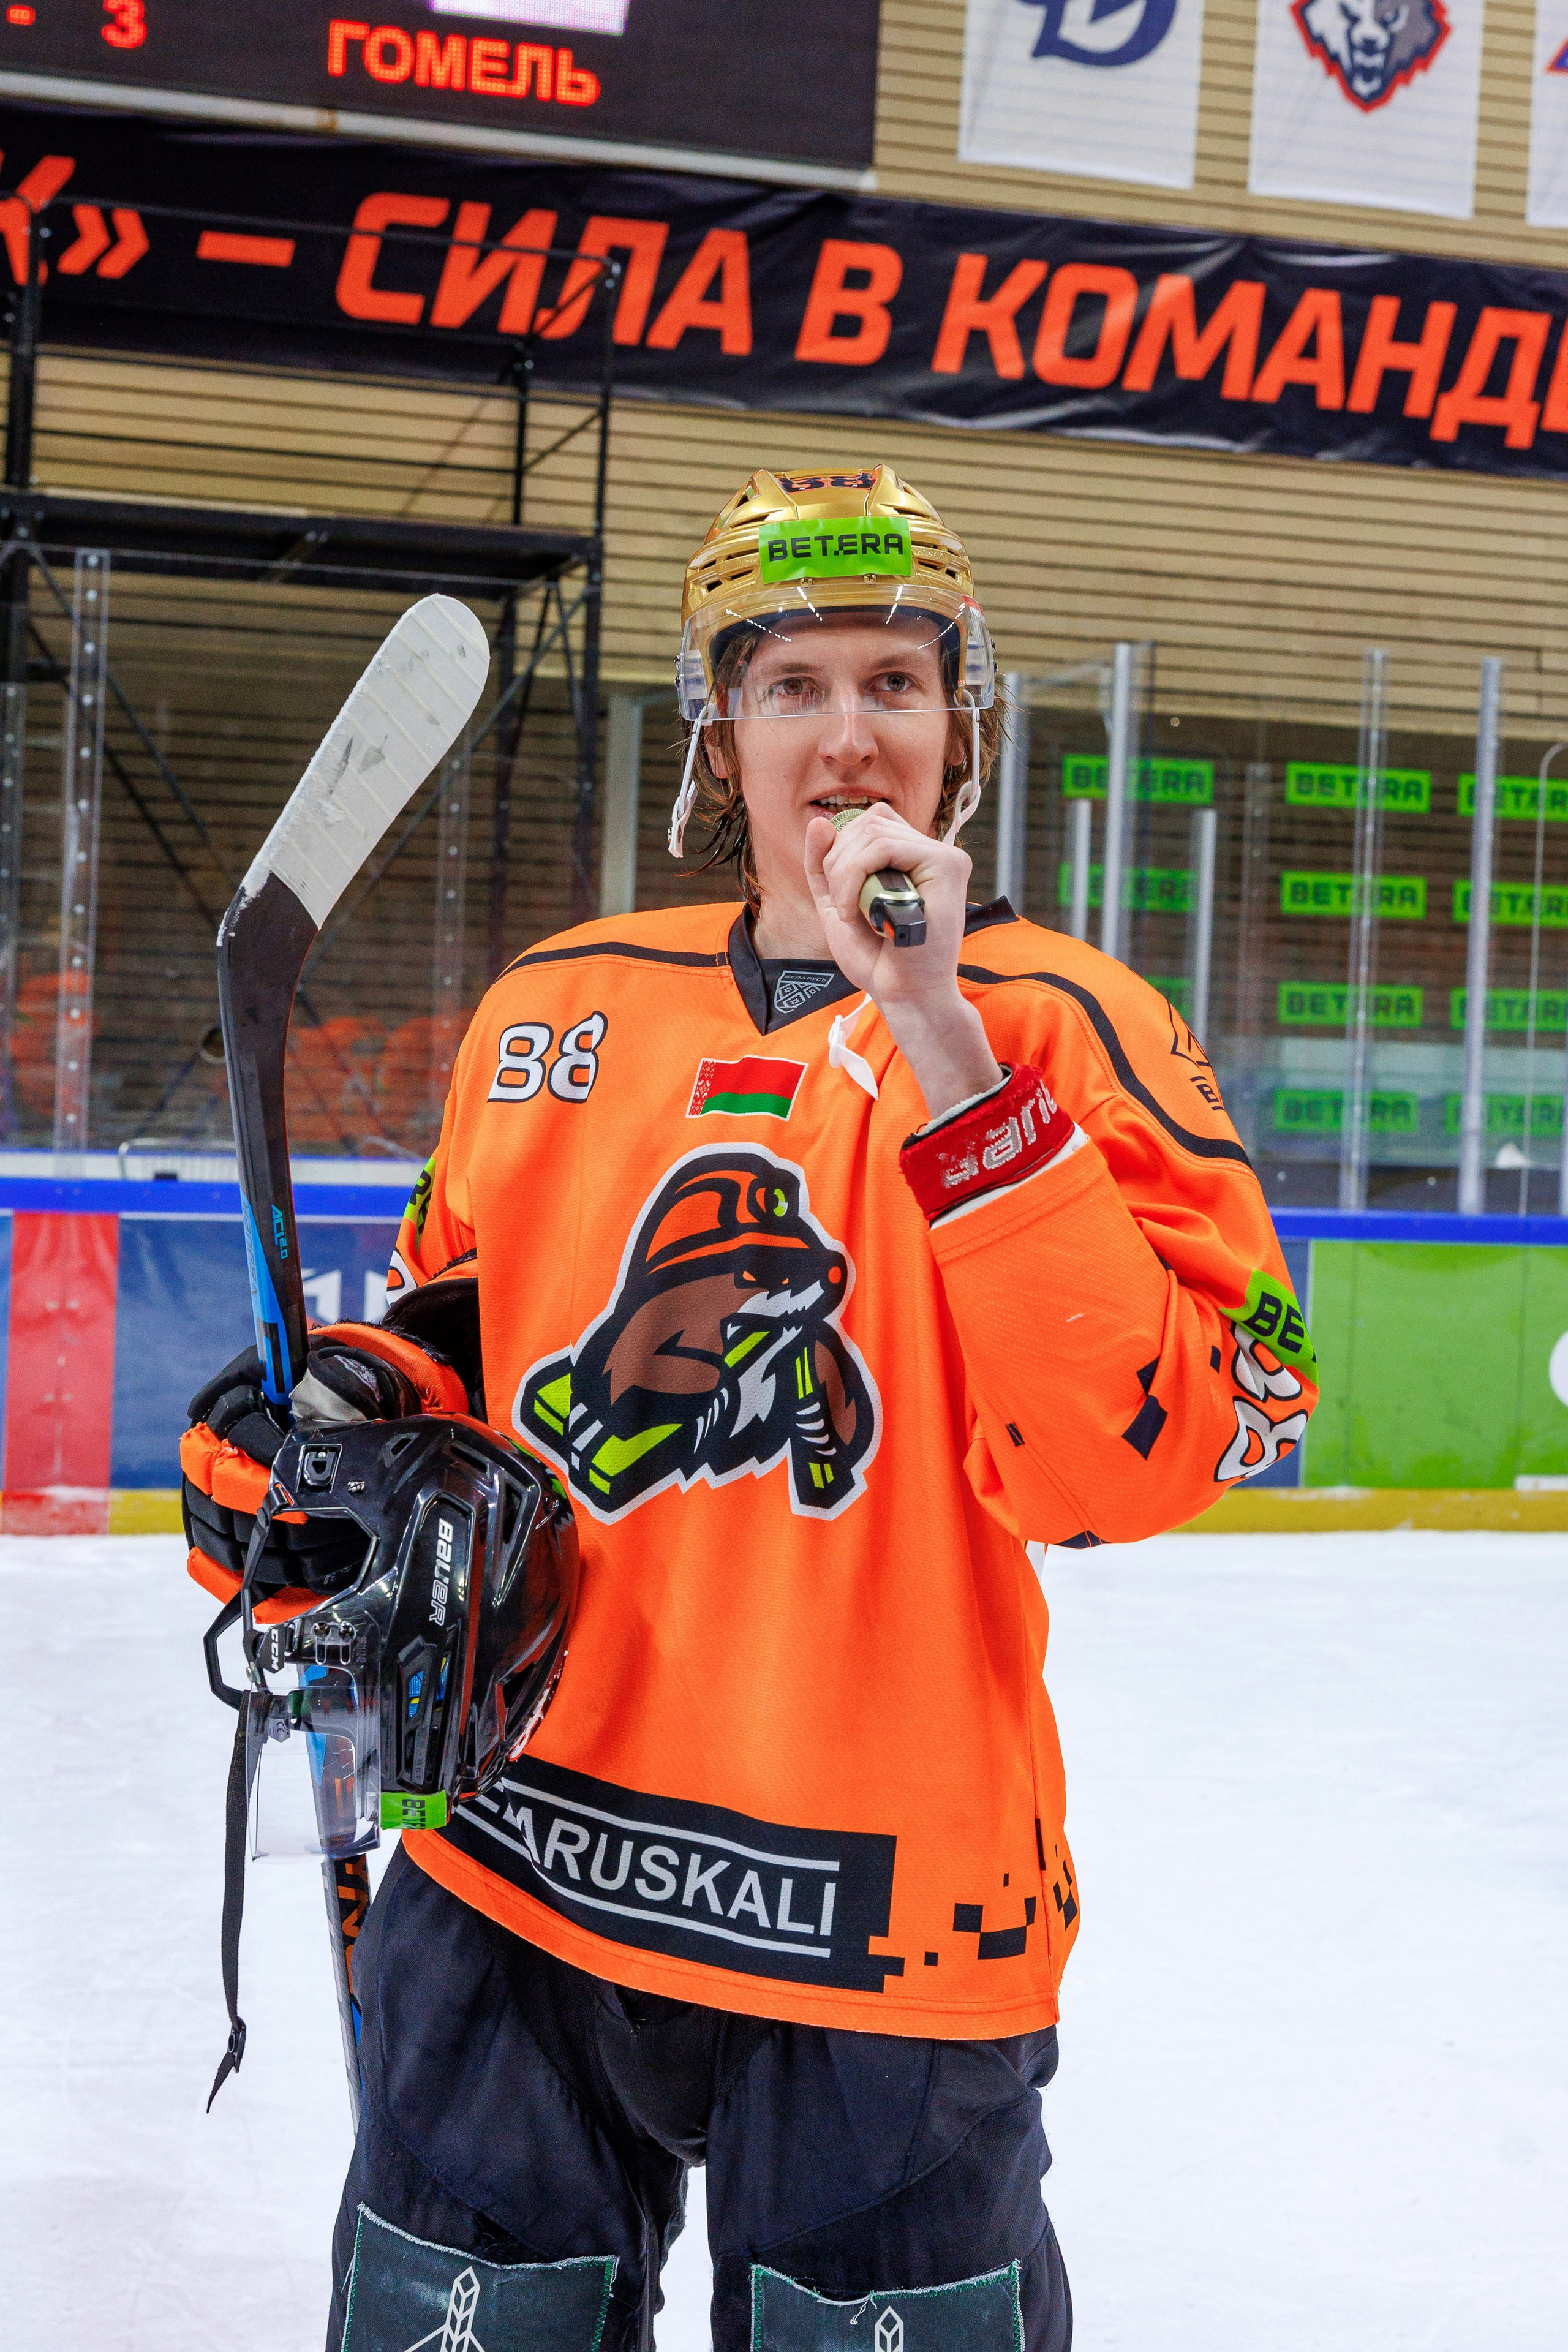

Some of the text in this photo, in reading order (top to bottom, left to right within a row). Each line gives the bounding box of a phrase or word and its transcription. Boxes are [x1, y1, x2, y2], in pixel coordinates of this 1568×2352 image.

[101, 0, 147, 48] 3
[328, 18, 601, 106] ГОМЕЛЬ
[335, 191, 753, 356] СИЛА
[794, 238, 903, 366] В
[931, 251, 1568, 450] КОМАНД
[486, 1011, 608, 1104] 88
[271, 1628, 279, 1671] CCM
[475, 1795, 836, 1937] ARUSKALI
